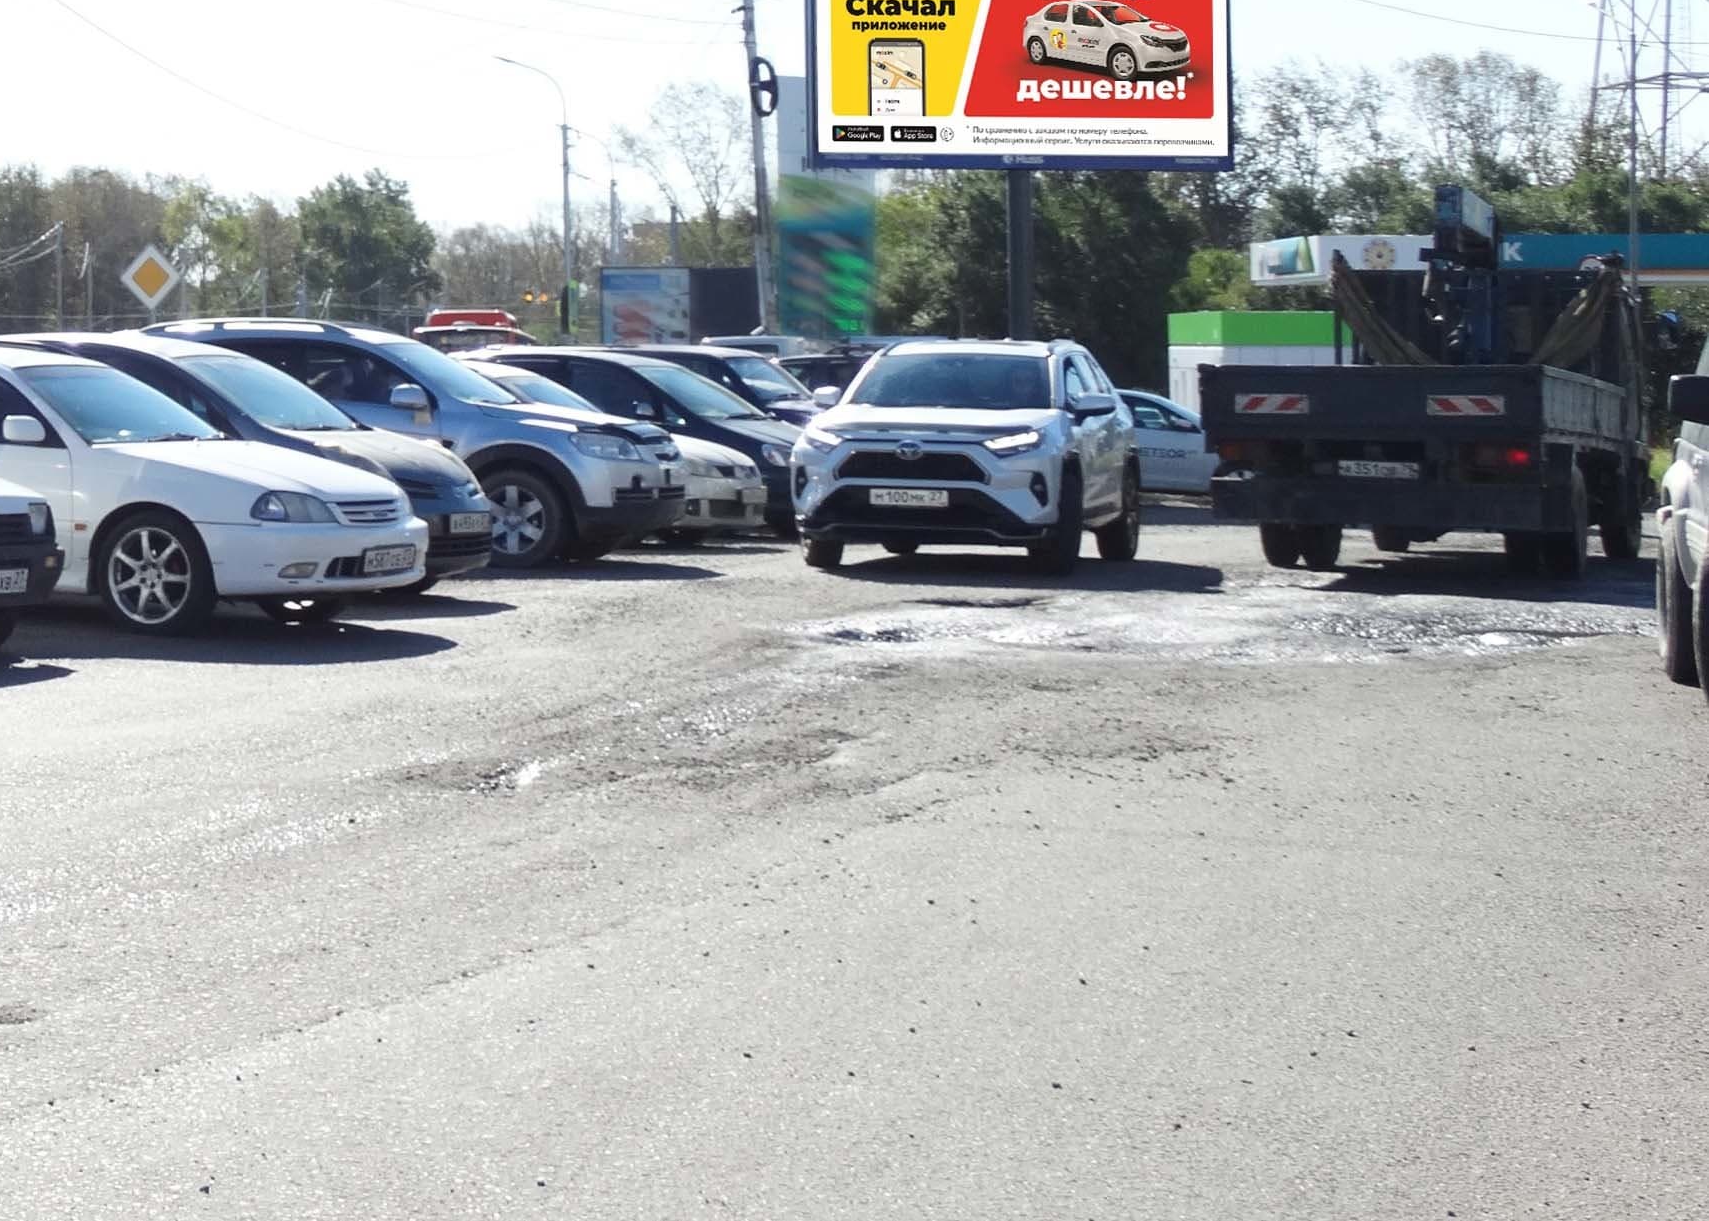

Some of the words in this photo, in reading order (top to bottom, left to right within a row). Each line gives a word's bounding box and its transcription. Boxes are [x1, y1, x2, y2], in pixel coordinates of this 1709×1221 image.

[852, 21, 946, 32] приложение
[847, 131, 869, 140] Google
[869, 131, 882, 140] Play
[903, 132, 916, 140] App
